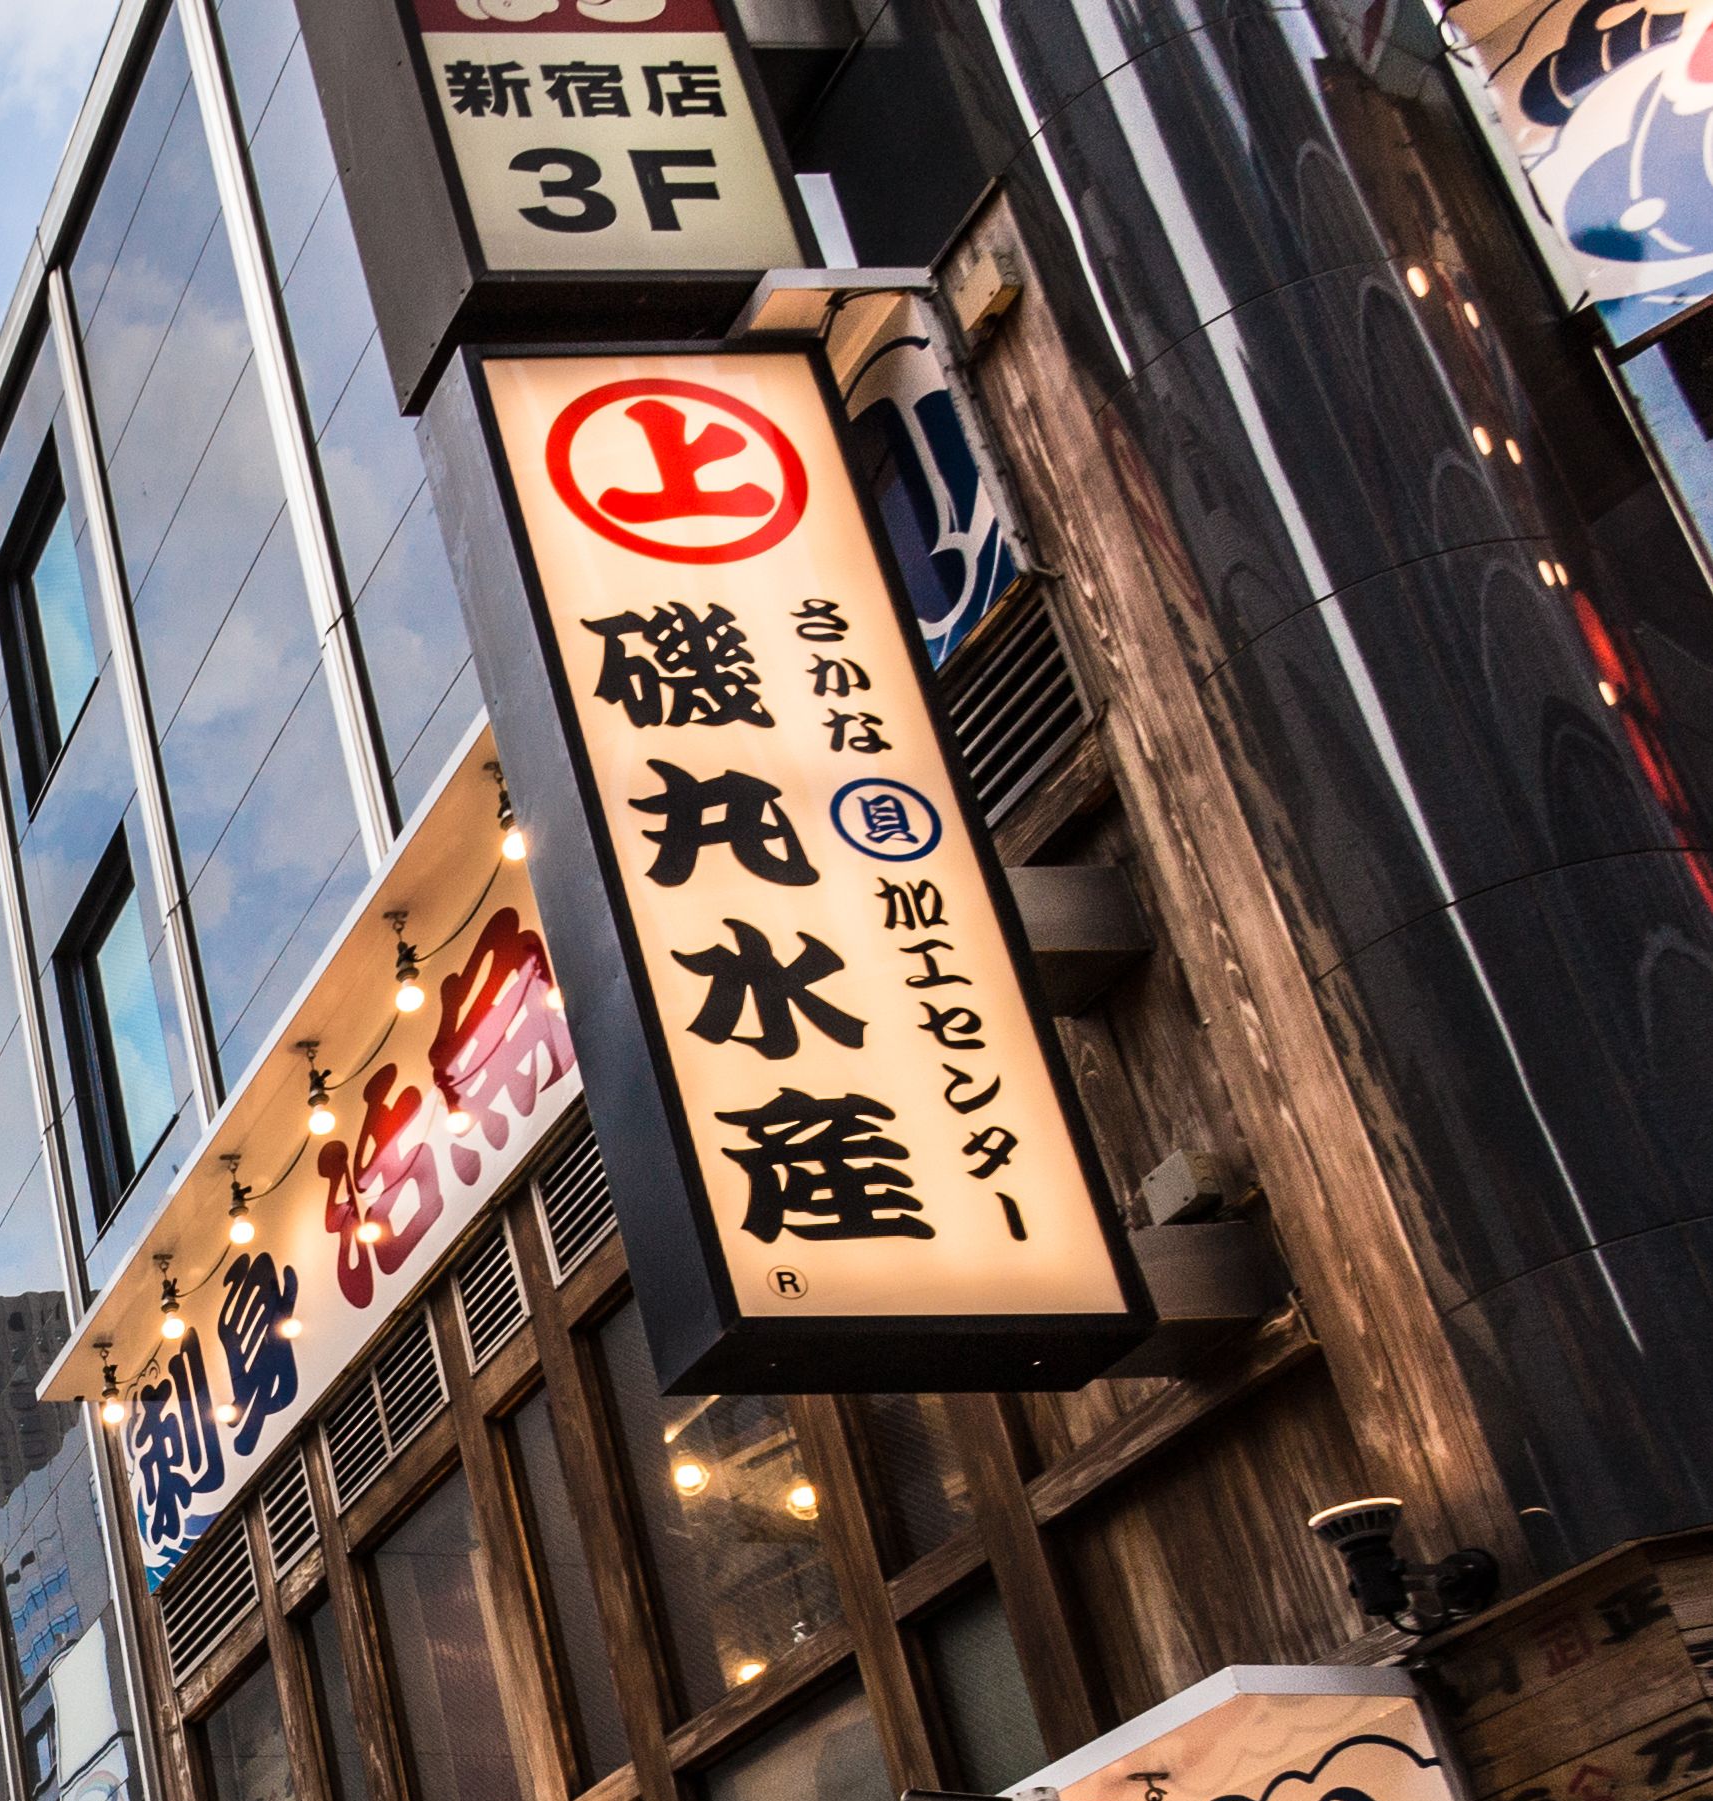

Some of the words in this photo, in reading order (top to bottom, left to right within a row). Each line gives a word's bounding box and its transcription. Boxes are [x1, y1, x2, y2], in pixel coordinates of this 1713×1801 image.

[444, 58, 728, 122] 新宿店
[507, 144, 725, 235] 3F
[788, 595, 895, 759] さかな
[578, 600, 939, 1248] 磯丸水産
[873, 874, 1034, 1246] 加工センター
[135, 1250, 300, 1543] 刺身
